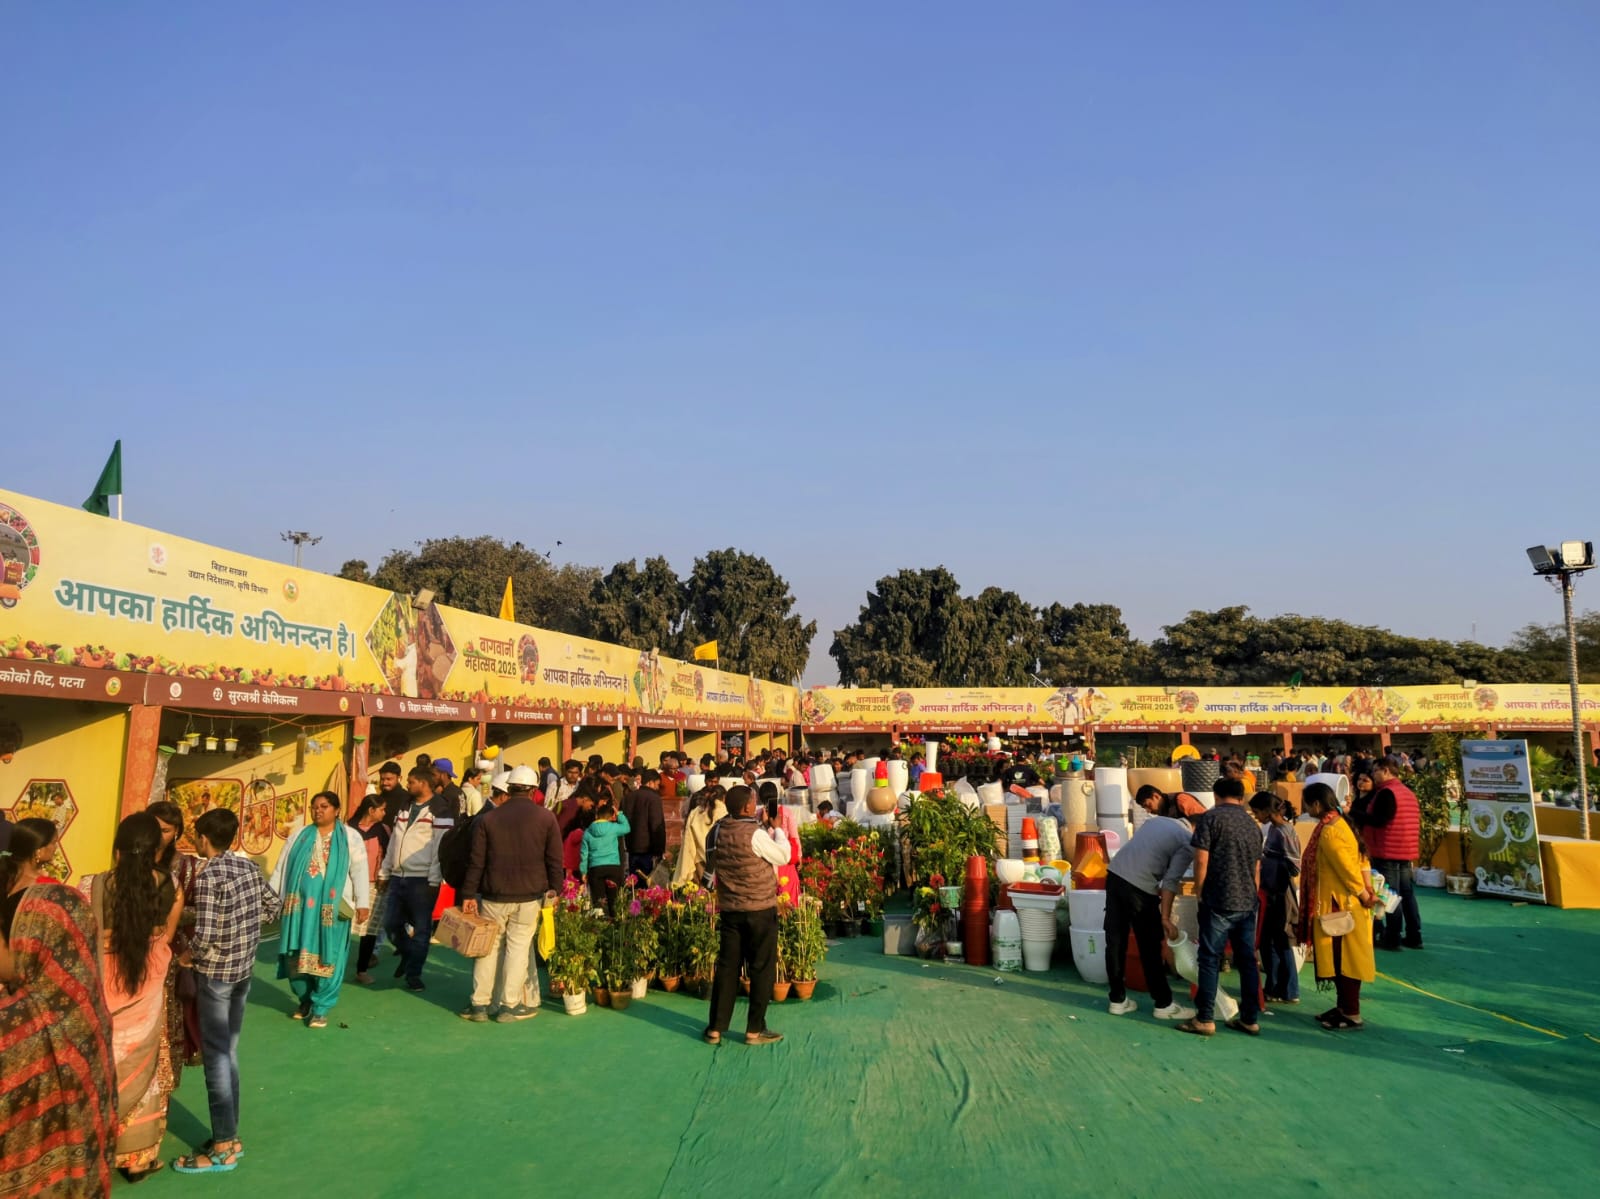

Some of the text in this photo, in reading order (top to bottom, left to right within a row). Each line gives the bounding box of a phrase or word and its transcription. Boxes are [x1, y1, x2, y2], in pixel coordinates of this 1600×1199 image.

[211, 560, 228, 573] बिहार
[54, 580, 155, 622] आपका
[161, 595, 235, 635] हार्दिक
[240, 610, 333, 651] अभिनन्दन
[498, 660, 517, 676] 2026
[0, 667, 86, 689] कोको पिट, पटना
[543, 668, 569, 685] आपका
[570, 667, 592, 688] हार्दिक
[593, 670, 623, 690] अभिनन्दन
[262, 692, 299, 707] केमिकल्स
[1504, 701, 1537, 710] आपका
[919, 704, 949, 712] आपका
[951, 702, 979, 713] हार्दिक
[981, 702, 1024, 713] अभिनन्दन
[1204, 704, 1237, 712] आपका
[1239, 702, 1269, 713] हार्दिक
[1271, 702, 1318, 713] अभिनन्दन
